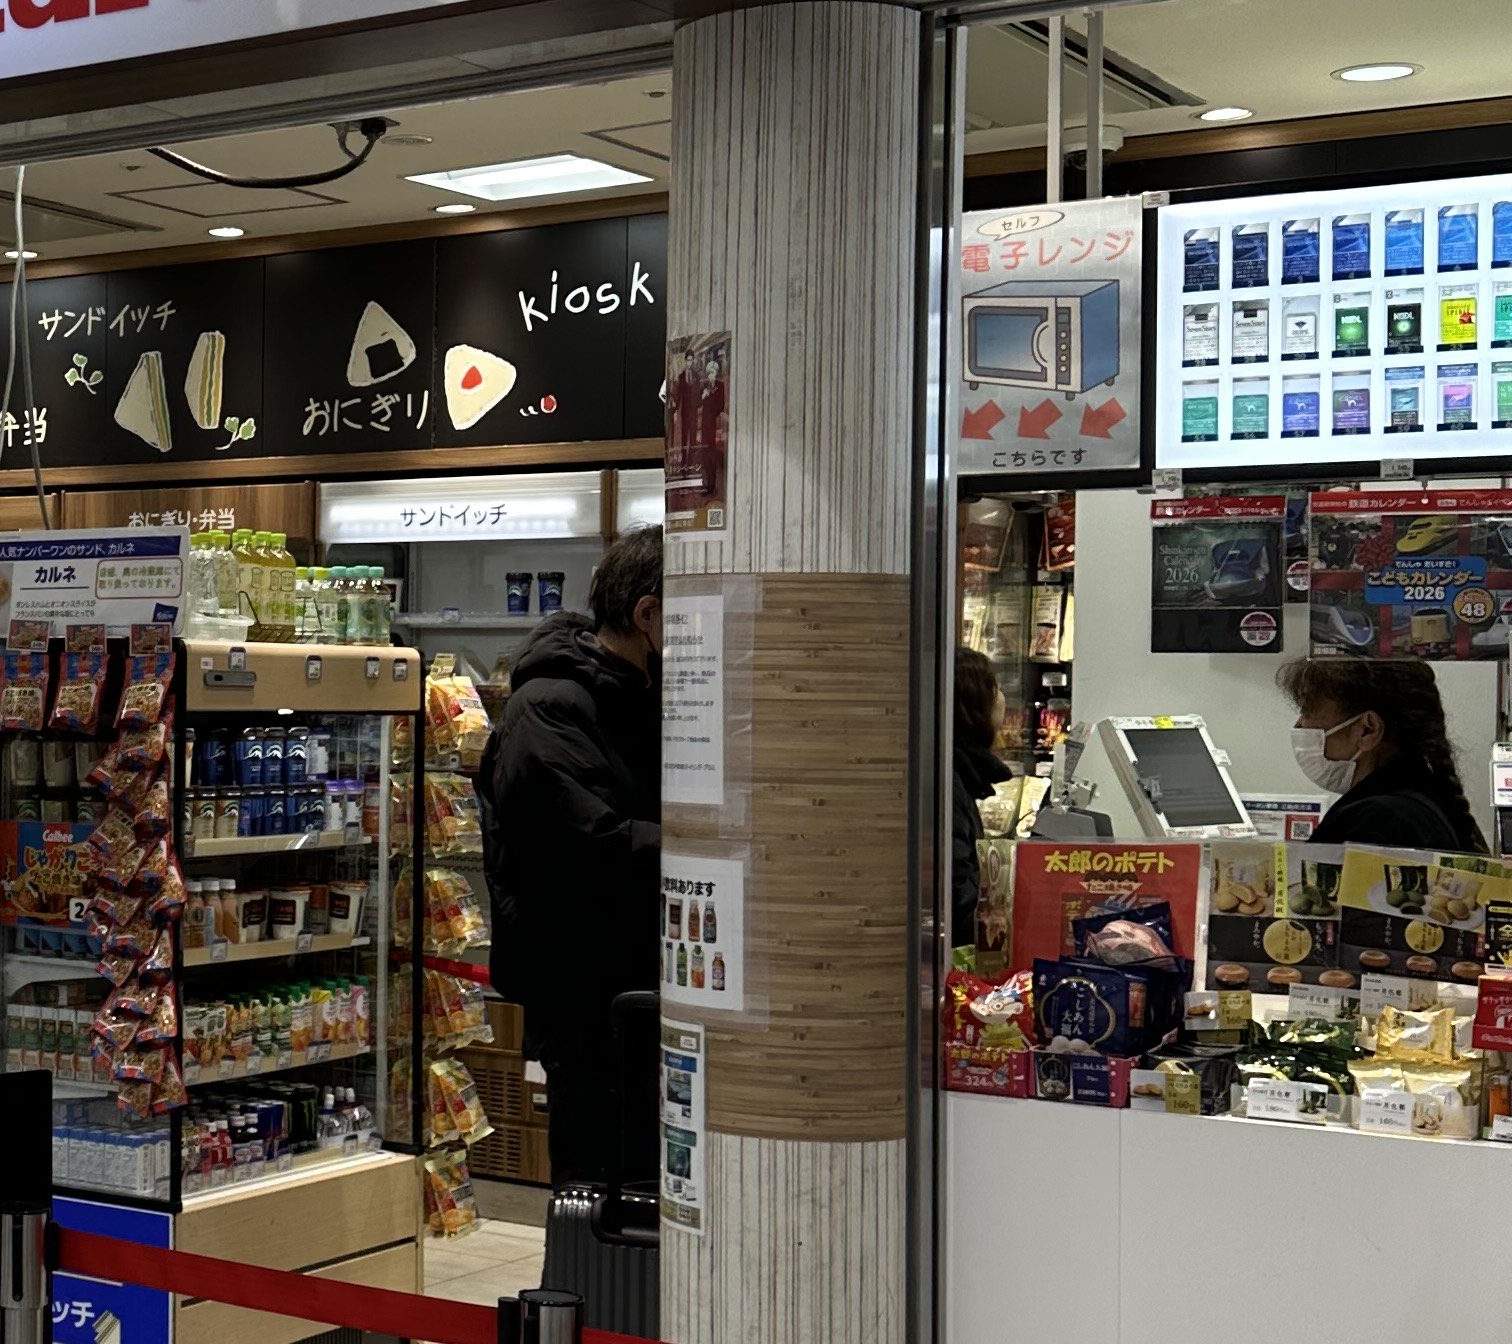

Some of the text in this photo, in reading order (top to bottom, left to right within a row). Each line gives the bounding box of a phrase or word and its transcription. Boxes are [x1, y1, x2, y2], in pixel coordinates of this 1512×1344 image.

[1001, 216, 1040, 230] セルフ
[962, 230, 1135, 273] 電子レンジ
[518, 261, 655, 332] kiosk
[38, 300, 177, 341] サンドイッチ
[302, 391, 431, 436] おにぎり
[992, 448, 1088, 467] こちらです
[129, 507, 236, 530] おにぎり・弁当
[399, 504, 508, 528] サンドイッチ
[34, 565, 77, 584] カルネ
[1165, 567, 1199, 584] 2026
[1367, 571, 1484, 587] こどもカレンダー
[1403, 585, 1446, 601] 2026
[1460, 602, 1486, 617] 48
[1044, 850, 1176, 874] 太郎のポテト
[1072, 985, 1085, 1036] こしあん
